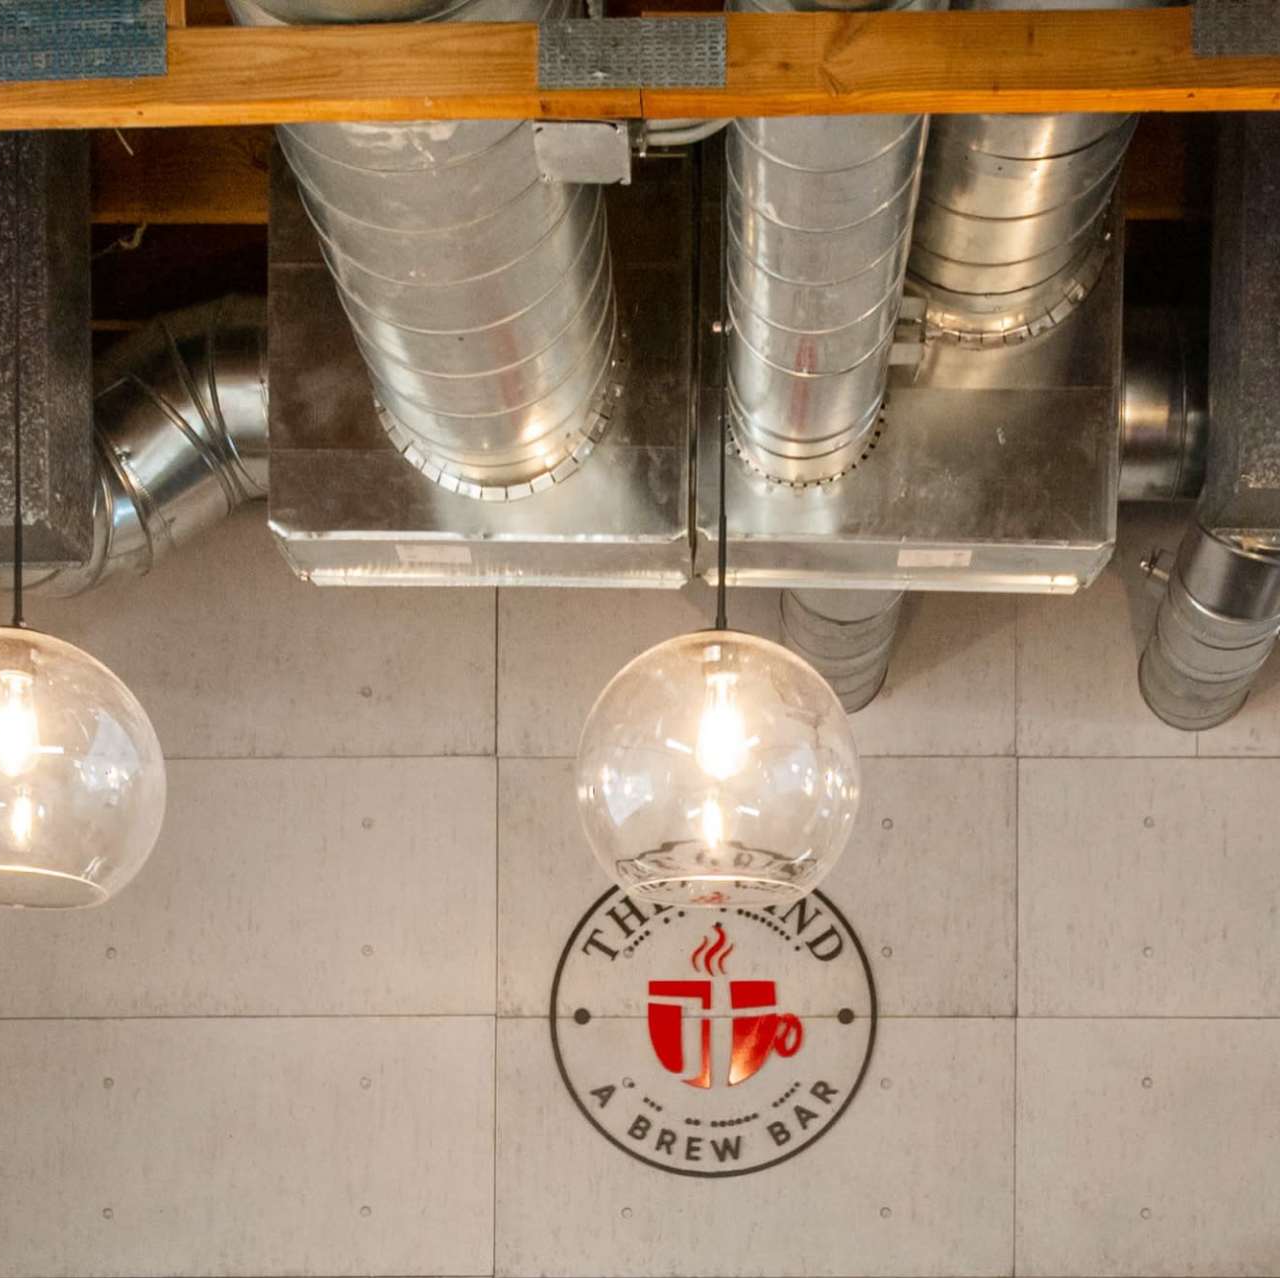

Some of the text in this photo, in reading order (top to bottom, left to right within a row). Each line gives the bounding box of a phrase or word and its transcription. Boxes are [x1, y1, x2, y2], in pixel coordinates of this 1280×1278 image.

[590, 1078, 840, 1162] A BREW BAR
